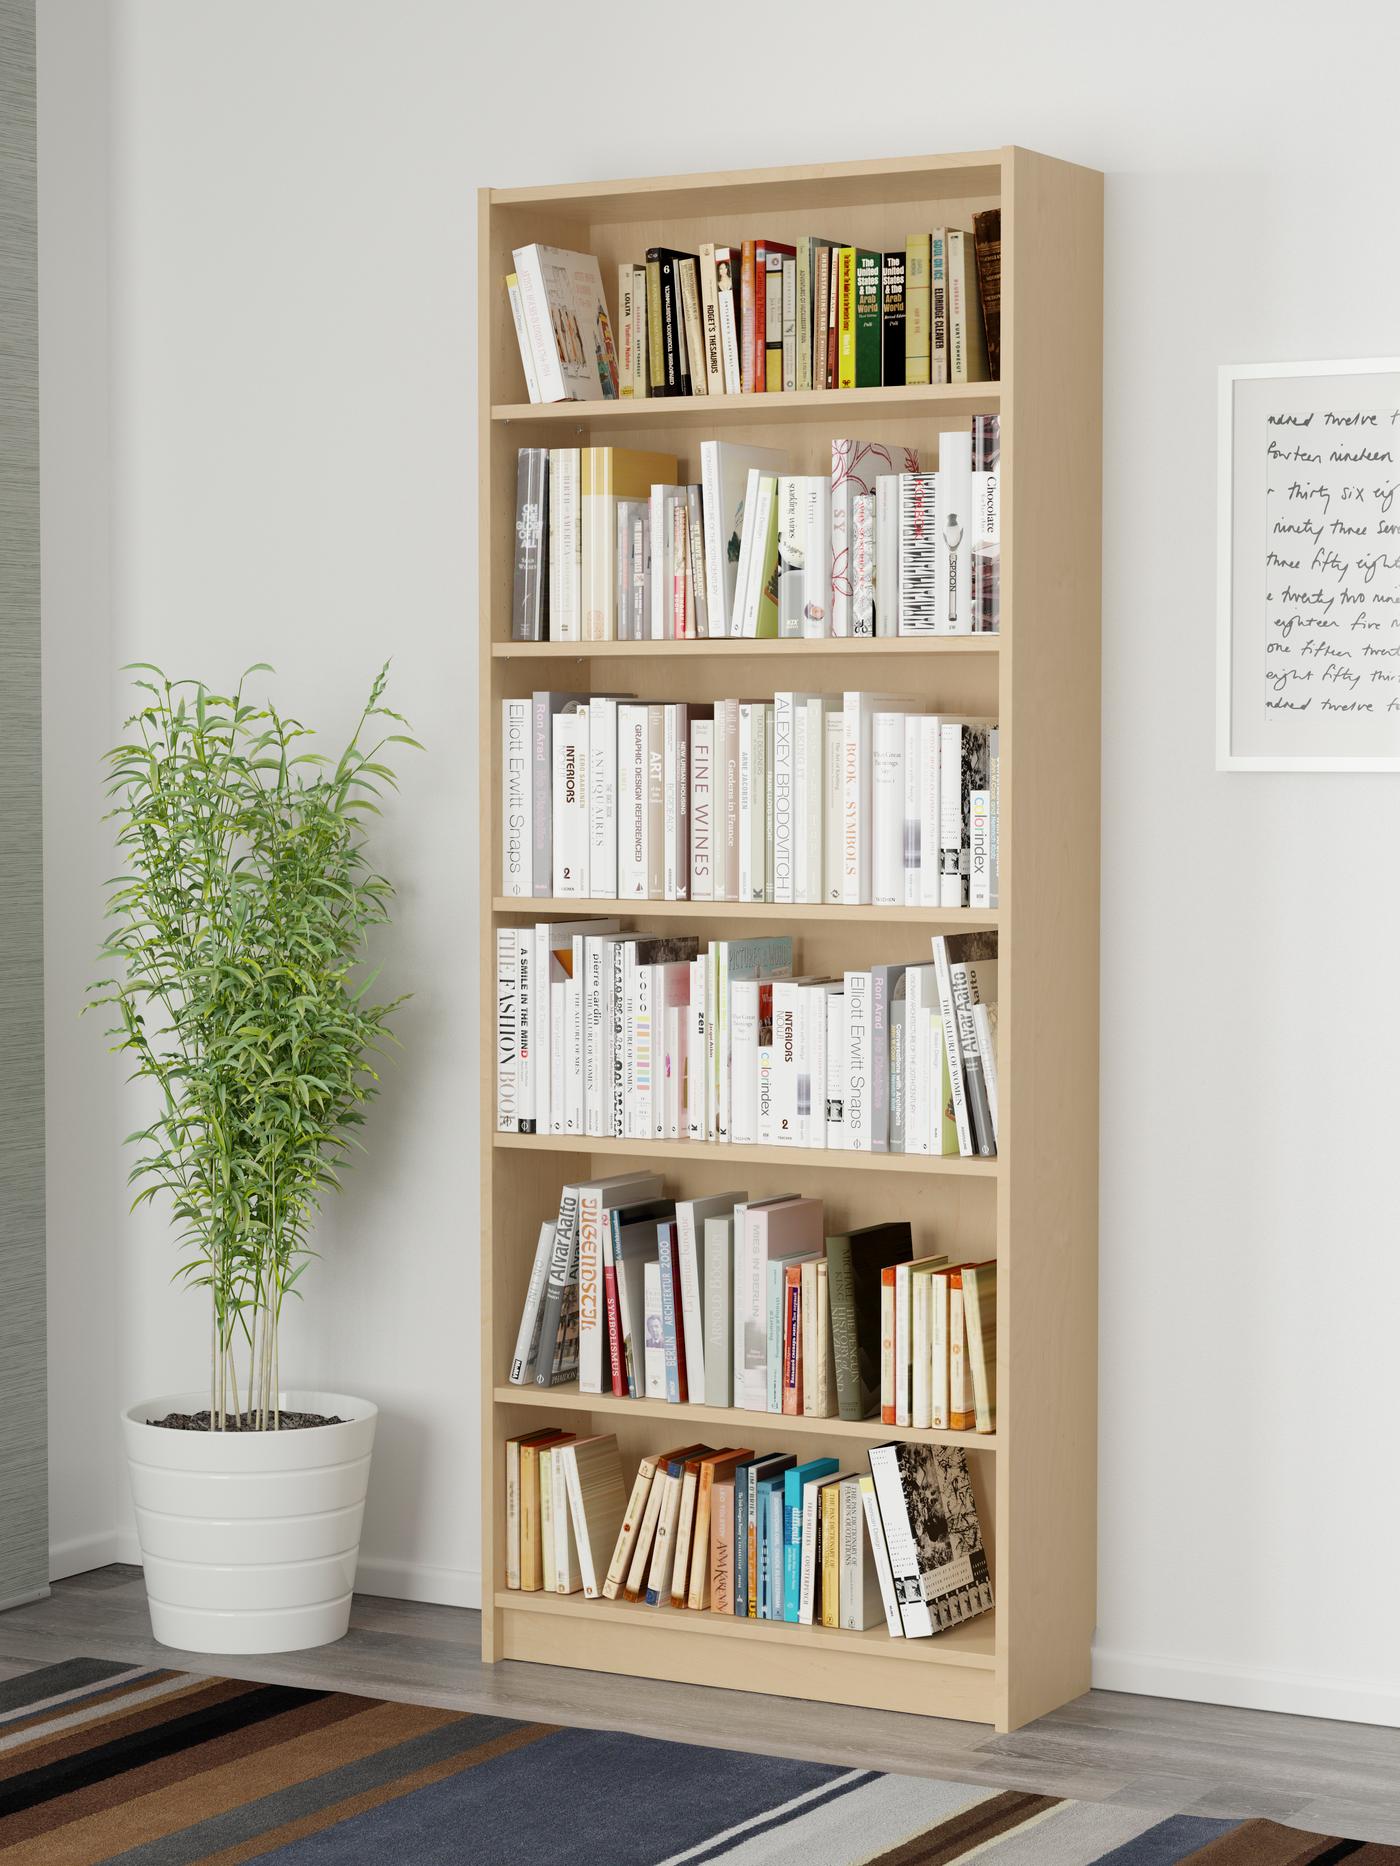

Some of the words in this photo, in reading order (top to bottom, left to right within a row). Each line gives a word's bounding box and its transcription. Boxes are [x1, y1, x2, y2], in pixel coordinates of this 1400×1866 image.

[887, 258, 899, 266] The
[934, 239, 942, 256] SOUL
[664, 265, 670, 274] 6
[857, 267, 878, 276] United
[862, 259, 874, 267] The
[883, 266, 904, 275] United
[934, 258, 943, 268] ON
[934, 270, 943, 280] ICE
[857, 276, 878, 286] States
[866, 286, 876, 294] the
[883, 275, 904, 284] States
[885, 286, 890, 294] &
[891, 285, 902, 293] the
[858, 304, 878, 312] World
[860, 295, 876, 303] Arab
[883, 303, 904, 312] World
[886, 294, 902, 302] Arab
[934, 288, 943, 319] ELDRIDGE
[708, 304, 716, 333] ROGET'S
[936, 321, 944, 349] CLEAVER
[709, 334, 718, 374] THESAURUS
[1324, 412, 1378, 426] twelve
[1267, 441, 1321, 463] fourteen
[1330, 443, 1393, 462] nineteen
[523, 504, 538, 514] OH
[987, 476, 996, 533] Chocolate
[1288, 481, 1330, 515] thirty
[1341, 486, 1364, 502] six
[522, 513, 538, 522] THE
[1273, 516, 1324, 545] ninety
[1330, 519, 1367, 535] three
[520, 539, 536, 548] ALL
[1267, 552, 1300, 568] three
[1311, 547, 1348, 583] fifty
[1282, 585, 1334, 614] twenty
[1340, 588, 1365, 604] two
[1274, 615, 1339, 638] eighteen
[1351, 611, 1380, 630] five
[1267, 643, 1290, 653] one
[1301, 640, 1352, 658] fifteen
[1266, 669, 1313, 691] eight
[1322, 664, 1360, 691] fifty
[536, 703, 545, 728] Ron
[1321, 698, 1373, 712] twelve
[509, 704, 524, 751] Elliott
[777, 698, 790, 766] ALEXEY
[536, 732, 545, 761] Arad
[634, 724, 642, 764] GRAPHIC
[566, 746, 574, 803] INTERIORS
[650, 752, 661, 781] ART
[695, 745, 708, 793] FINE
[846, 744, 856, 784] BOOK
[509, 758, 524, 808] Erwitt
[634, 768, 642, 800] DESIGN
[728, 760, 736, 800] Gardens
[594, 748, 604, 848] ANTIQUAIRES
[728, 801, 736, 811] in
[507, 815, 524, 873] Snaps
[634, 804, 642, 862] REFERENCED
[695, 804, 708, 876] WINES
[728, 814, 736, 846] France
[777, 774, 790, 889] BRODOVITCH
[846, 801, 856, 875] SYMBOLS
[974, 796, 987, 874] colorindex
[564, 868, 570, 879] 2
[500, 931, 515, 973] THE
[521, 994, 528, 1004] IN
[851, 977, 864, 1019] Elliott
[875, 977, 883, 999] Ron
[954, 971, 971, 1012] Aalto
[500, 979, 516, 1064] FASHION
[875, 1003, 883, 1029] Arad
[574, 1044, 580, 1052] OF
[851, 1025, 864, 1070] Erwitt
[945, 1019, 955, 1054] ALLURE
[958, 1014, 978, 1054] Alvar
[587, 1045, 593, 1053] OF
[627, 1050, 633, 1060] OF
[950, 1056, 957, 1067] OF
[761, 1052, 771, 1115] colorindex
[952, 1070, 962, 1106] WOMEN
[848, 1076, 865, 1128] Snaps
[782, 1119, 788, 1130] 2
[557, 1197, 576, 1243] Aalto
[752, 1224, 760, 1253] MIES
[550, 1239, 570, 1282] Alvar
[581, 1198, 597, 1331] JUGENDSTIL
[660, 1241, 670, 1268] 2000
[752, 1258, 760, 1270] IN
[835, 1271, 843, 1303] KING
[842, 1248, 852, 1302] MICHAEL
[663, 1272, 673, 1326] ARCHITEKTUR
[684, 1300, 693, 1312] La
[752, 1273, 760, 1318] BERLIN
[710, 1294, 723, 1346] ARNOLD
[831, 1307, 840, 1332] NEW
[839, 1307, 849, 1359] HISTORY
[846, 1307, 855, 1331] THE
[607, 1298, 619, 1377] SYMBOLISMUS
[666, 1336, 676, 1366] BERLIN
[834, 1334, 844, 1392] ZEALAND
[842, 1360, 848, 1370] of
[848, 1333, 860, 1382] PENGUIN
[792, 1507, 800, 1544] difficult
[716, 1539, 727, 1570] ANNA
[851, 1557, 856, 1566] OF
